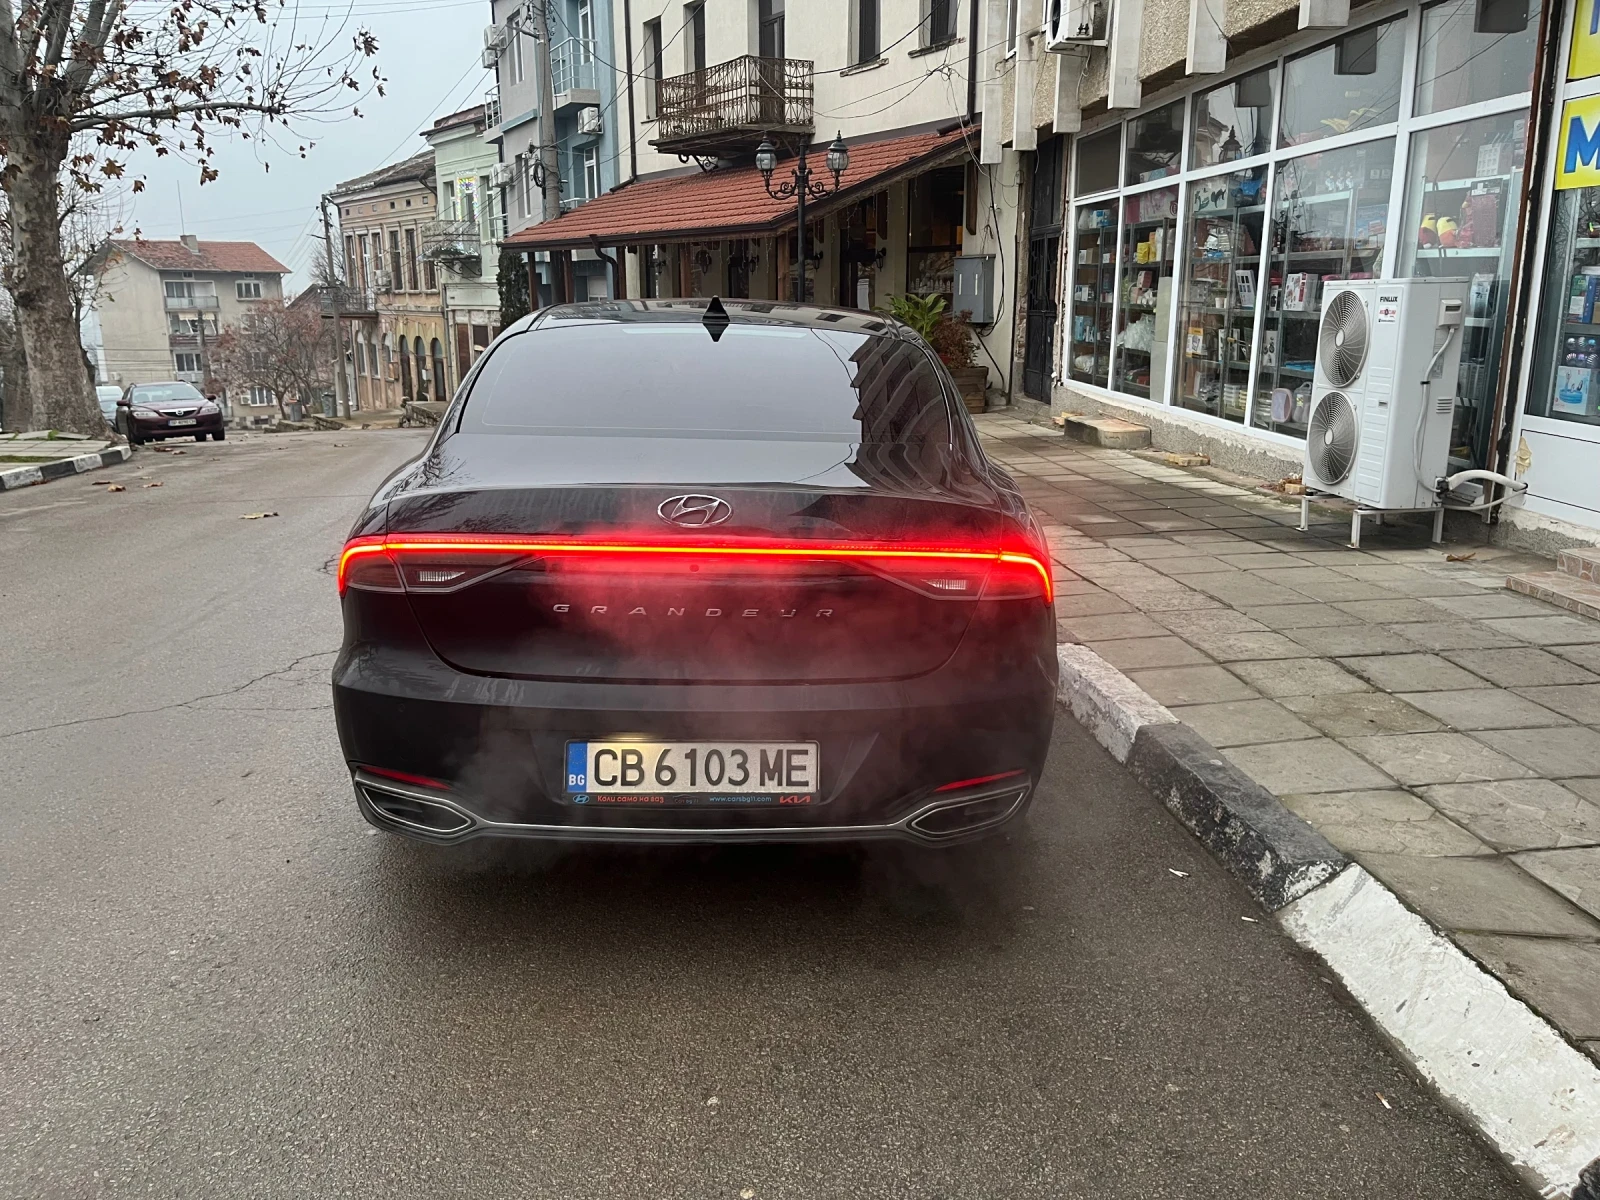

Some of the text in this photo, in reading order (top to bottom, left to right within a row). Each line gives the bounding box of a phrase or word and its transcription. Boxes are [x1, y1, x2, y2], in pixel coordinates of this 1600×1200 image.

[552, 603, 834, 618] GRANDEUR
[593, 748, 810, 787] CB 6103 ME
[569, 774, 585, 786] BG
[597, 795, 615, 803] Коли
[779, 795, 811, 804] KIA
